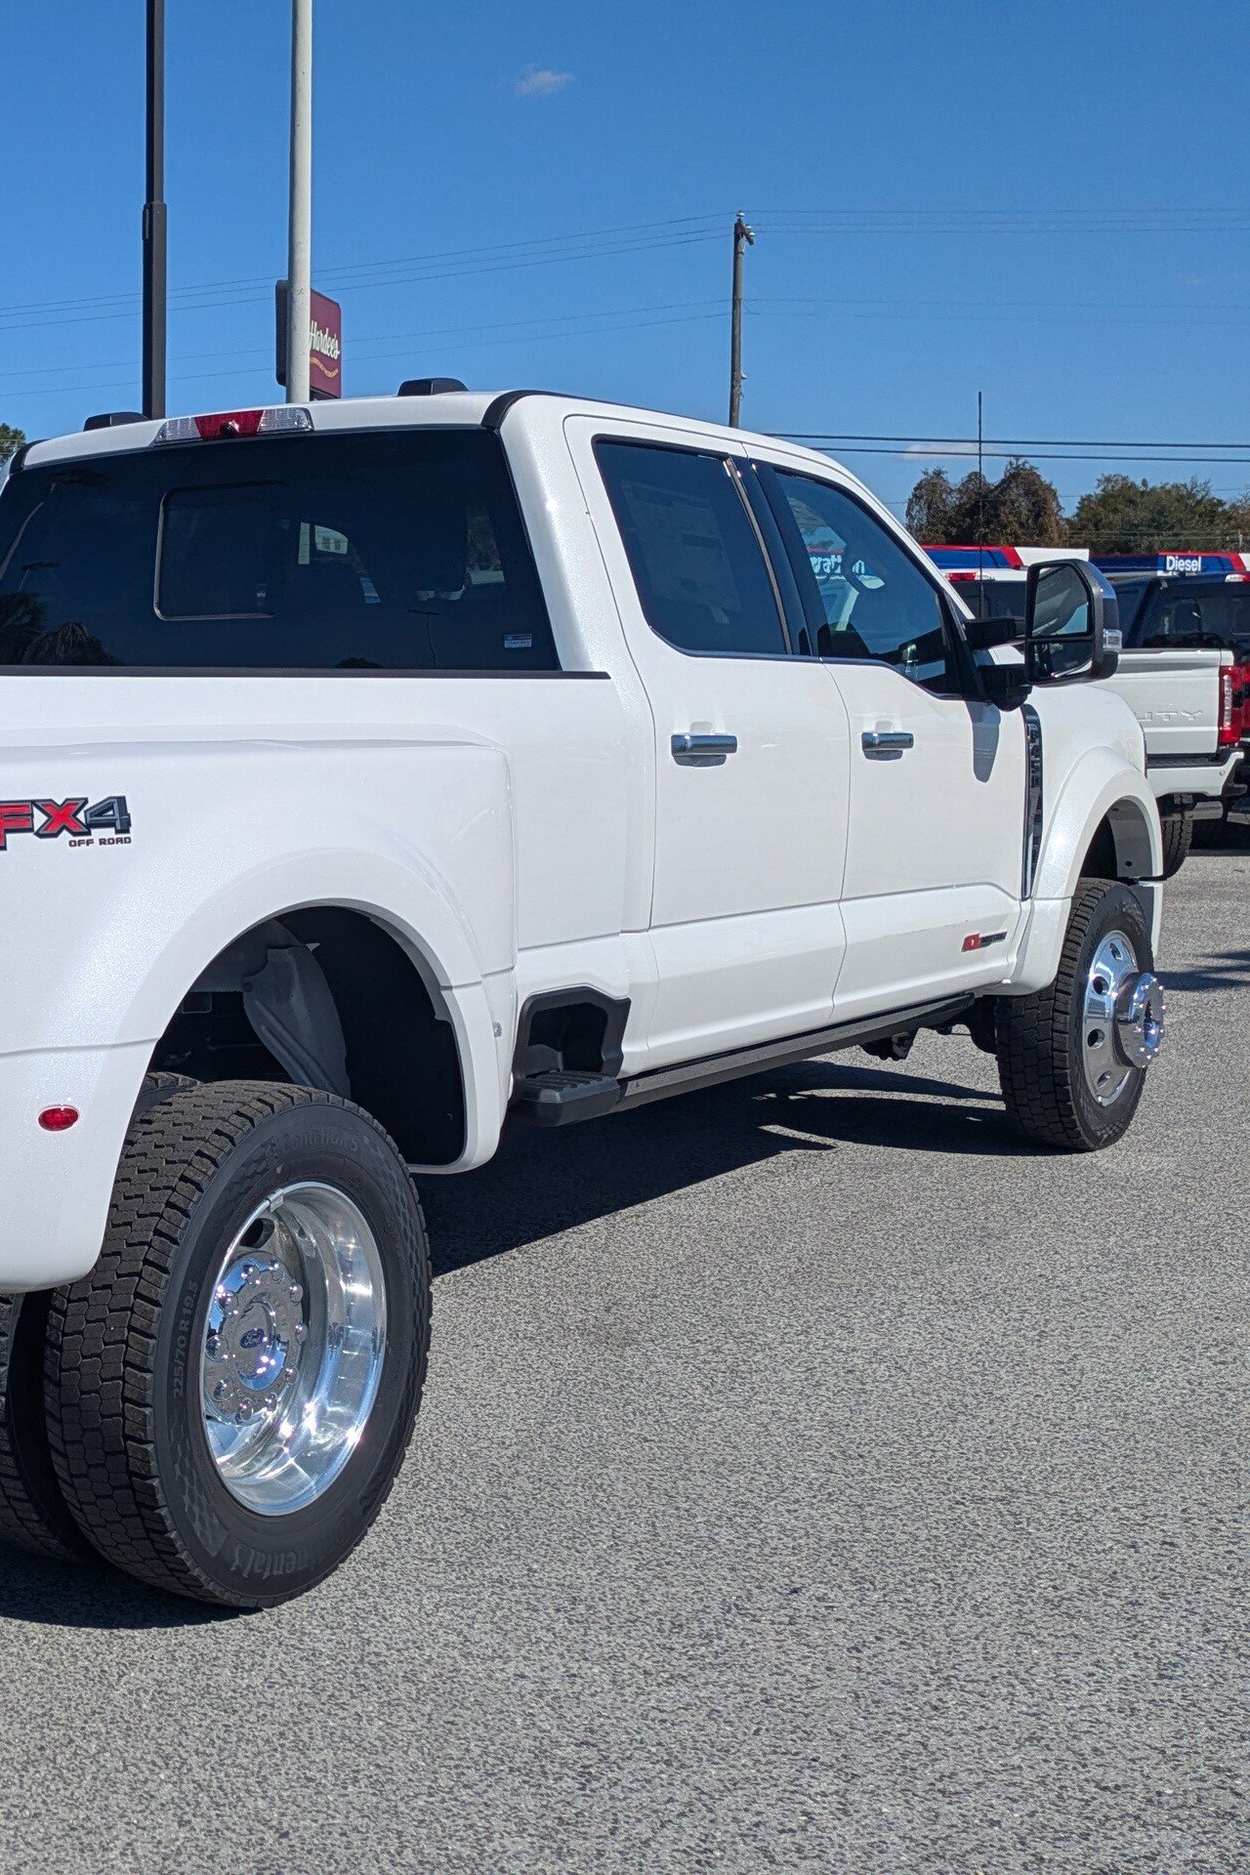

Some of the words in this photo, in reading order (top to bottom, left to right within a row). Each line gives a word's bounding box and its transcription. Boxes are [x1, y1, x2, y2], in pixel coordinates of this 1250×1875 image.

[1166, 555, 1202, 572] Diesel
[68, 838, 95, 848] OFF
[98, 836, 132, 846] ROAD
[173, 1335, 188, 1399] 225/70
